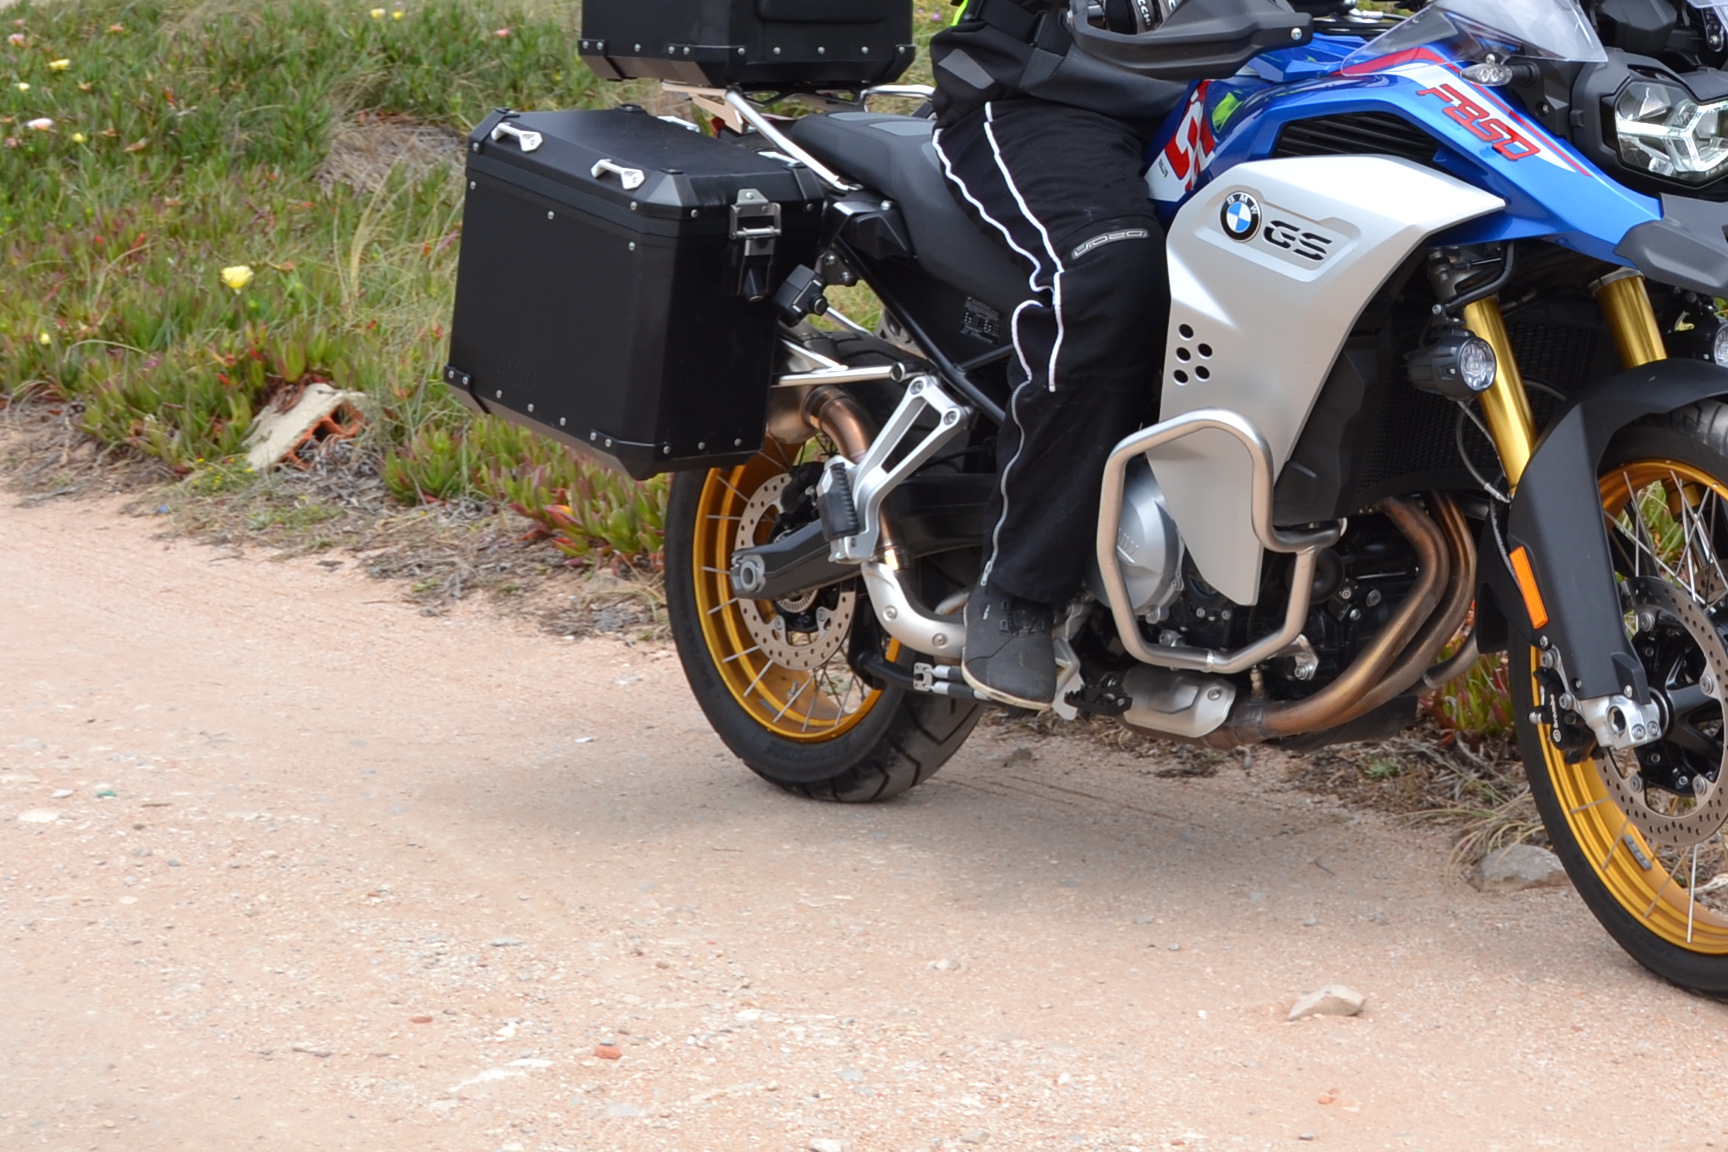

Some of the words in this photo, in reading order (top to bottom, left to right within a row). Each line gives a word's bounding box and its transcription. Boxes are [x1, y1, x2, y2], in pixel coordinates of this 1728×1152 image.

[1415, 83, 1541, 162] F850
[1226, 193, 1260, 215] BMW
[1263, 220, 1333, 261] GS
